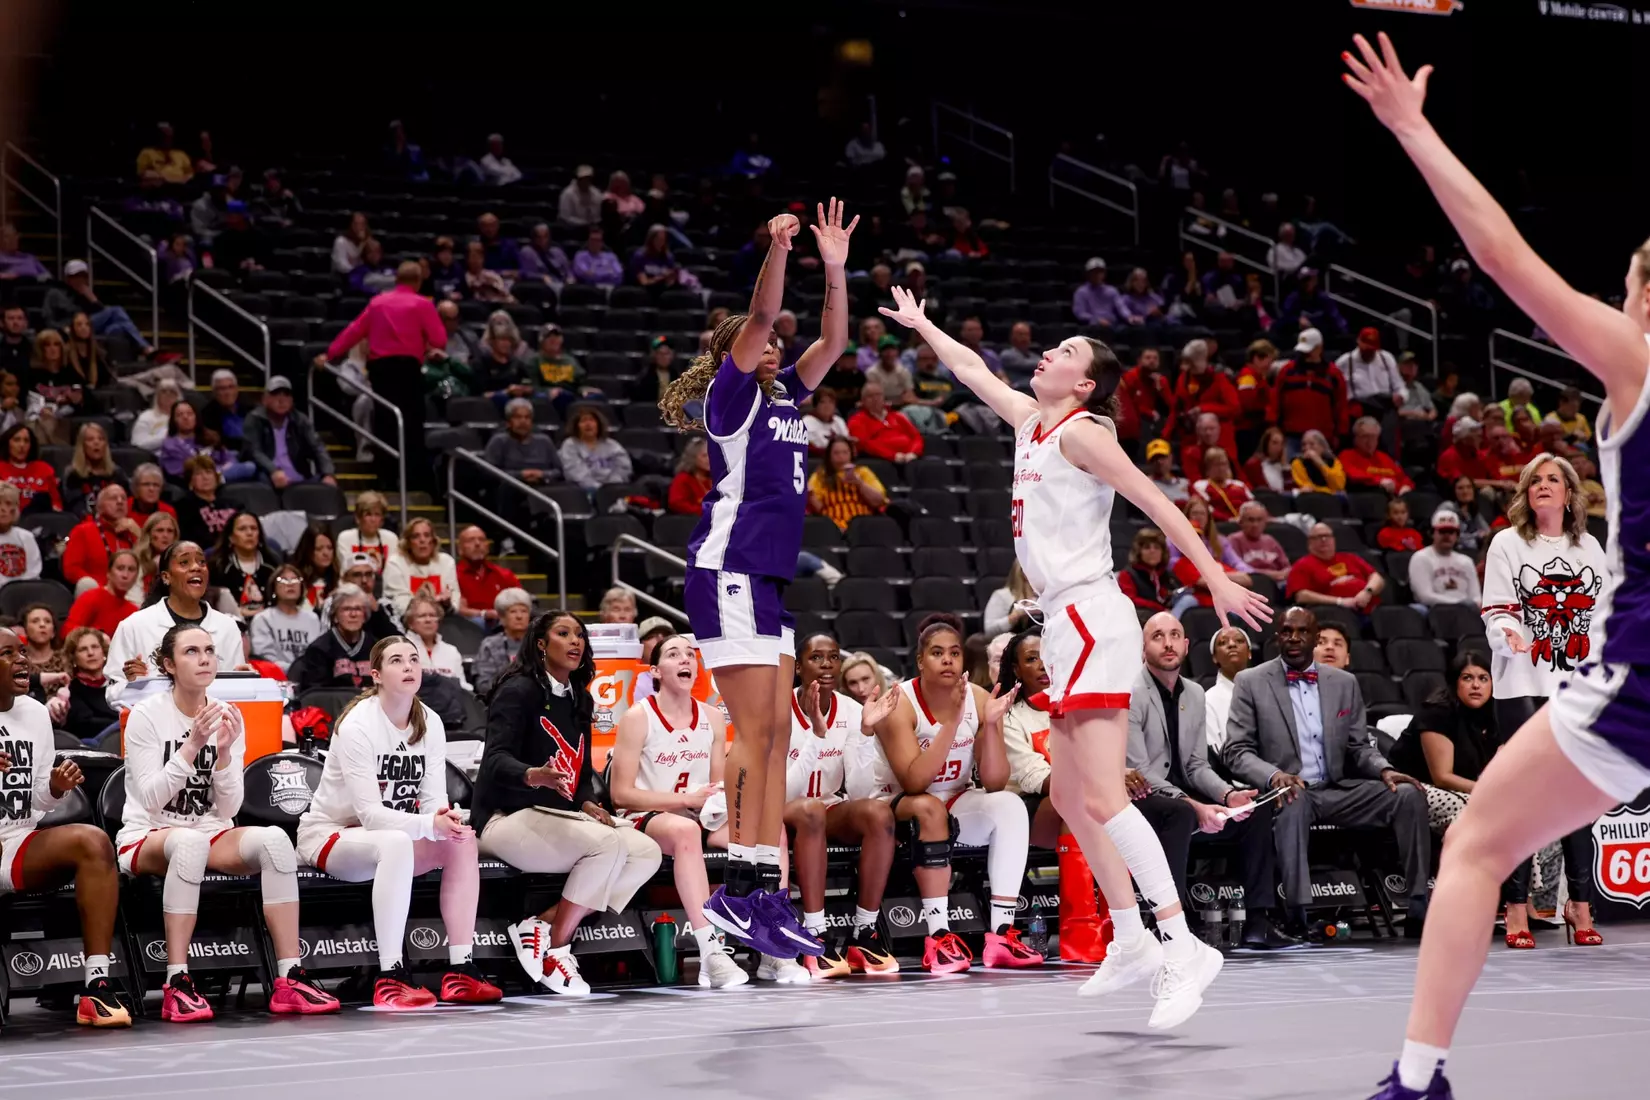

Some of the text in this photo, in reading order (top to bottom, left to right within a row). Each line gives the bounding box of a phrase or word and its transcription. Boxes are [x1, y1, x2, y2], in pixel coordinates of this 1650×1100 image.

[793, 451, 805, 495] 5
[277, 629, 309, 643] LADY
[590, 676, 616, 706] G
[654, 751, 678, 768] Lady
[6, 772, 31, 786] ON
[189, 774, 213, 786] ON
[270, 771, 308, 792] XII
[674, 772, 690, 793] 2
[807, 770, 822, 798] 11
[396, 784, 421, 797] ON
[1600, 822, 1650, 841] PHILLIP
[1609, 847, 1650, 886] 66
[1310, 881, 1357, 898] llstate
[572, 923, 636, 942] Allstate
[312, 937, 380, 956] Allstate
